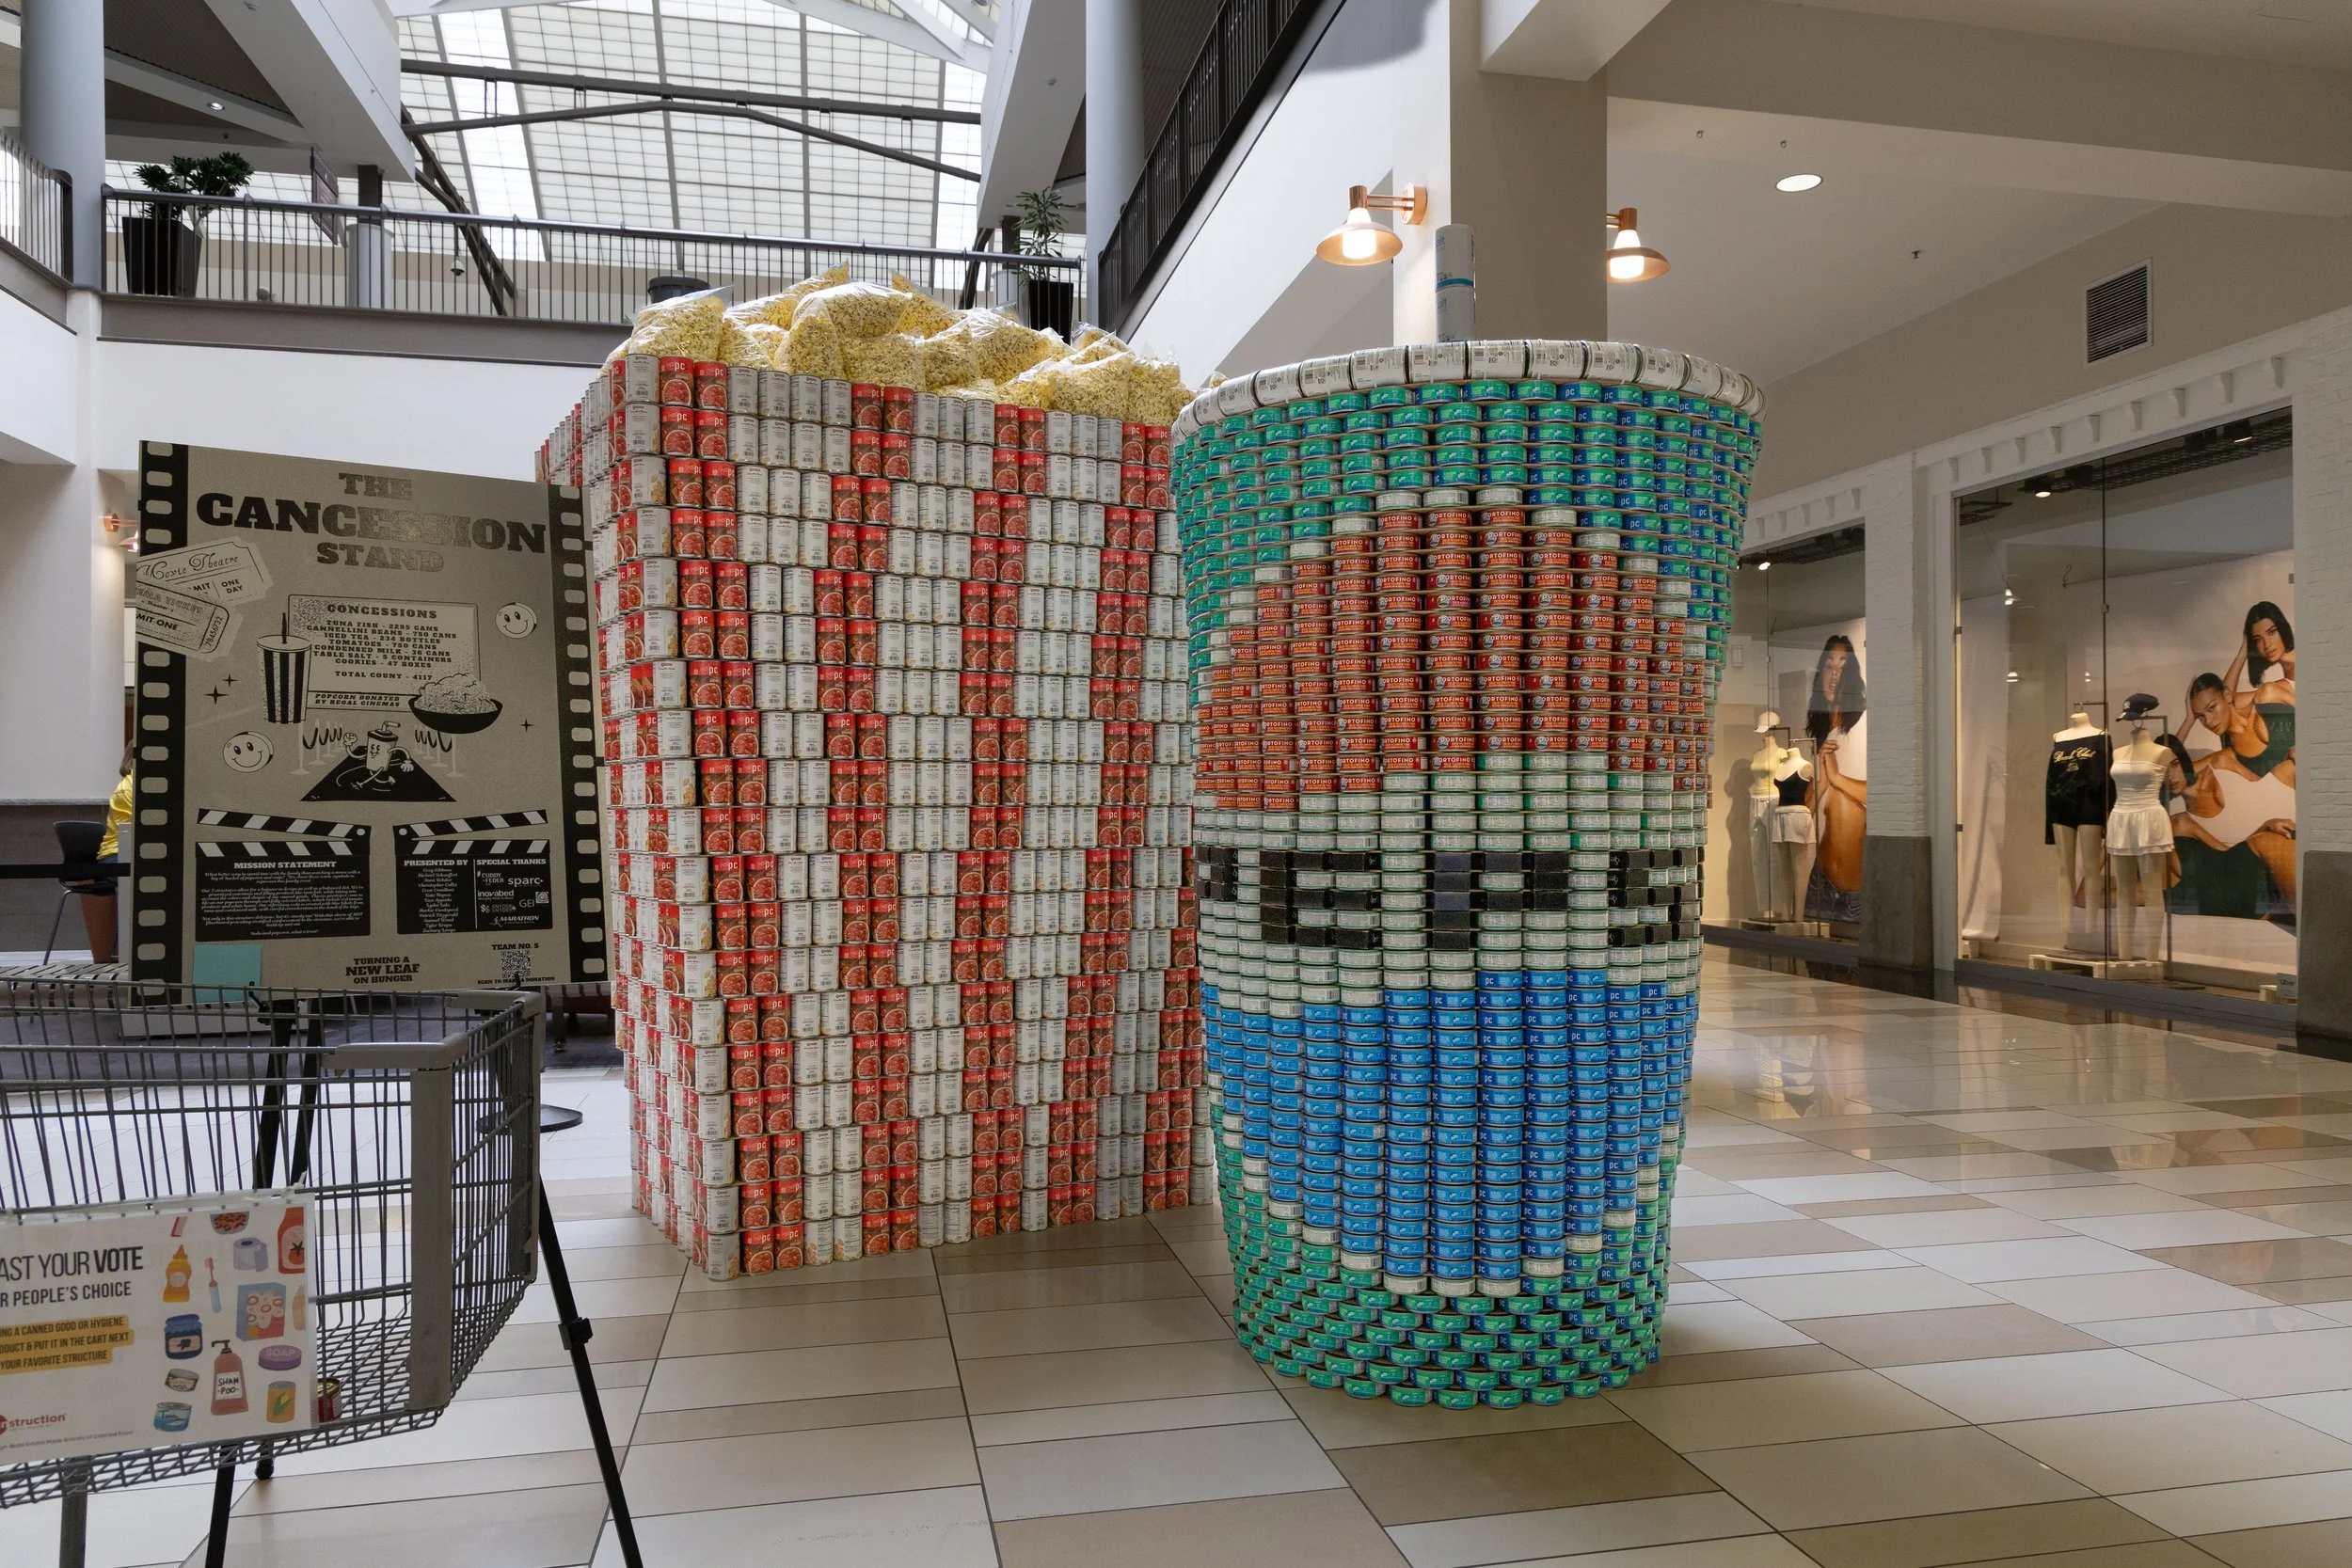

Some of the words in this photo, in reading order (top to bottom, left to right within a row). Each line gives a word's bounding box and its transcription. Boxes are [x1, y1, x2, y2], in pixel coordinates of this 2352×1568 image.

[1565, 388, 1574, 397] pc
[339, 472, 414, 500] THE
[196, 492, 548, 554] CANCESSION
[316, 542, 444, 572] STAND
[222, 578, 240, 587] ONE
[227, 585, 243, 594] DAY
[327, 604, 437, 619] CONCESSIONS
[157, 619, 178, 630] ONE
[307, 626, 367, 634] CANNELLINI
[329, 639, 382, 647] TOMATOES
[314, 644, 373, 653] CONDENSED
[391, 655, 452, 663] CONTAINERS
[508, 877, 541, 887] sparc
[519, 899, 534, 908] GEI
[354, 957, 400, 965] TURNING
[345, 965, 382, 976] NEW
[386, 963, 420, 974] LEAF
[371, 974, 413, 983] HUNGER
[39, 1251, 90, 1278] YOUR
[94, 1246, 143, 1273] VOTE
[13, 1286, 78, 1307] PEOPLE'S
[83, 1281, 132, 1300] CHOICE
[15, 1327, 20, 1336] A
[22, 1323, 54, 1336] CANNED
[56, 1322, 76, 1332] GOOD
[78, 1321, 88, 1329] OR
[90, 1317, 124, 1328] HYGIENE
[34, 1340, 49, 1350] PUT
[51, 1339, 58, 1349] IT
[60, 1338, 68, 1347] IN
[71, 1337, 85, 1346] THE
[87, 1335, 106, 1345] CART
[108, 1332, 130, 1342] NEXT
[266, 1348, 295, 1356] SOAP
[24, 1354, 61, 1368] FAVORITE
[63, 1350, 107, 1363] STRUCTURE
[218, 1377, 239, 1386] SHAM
